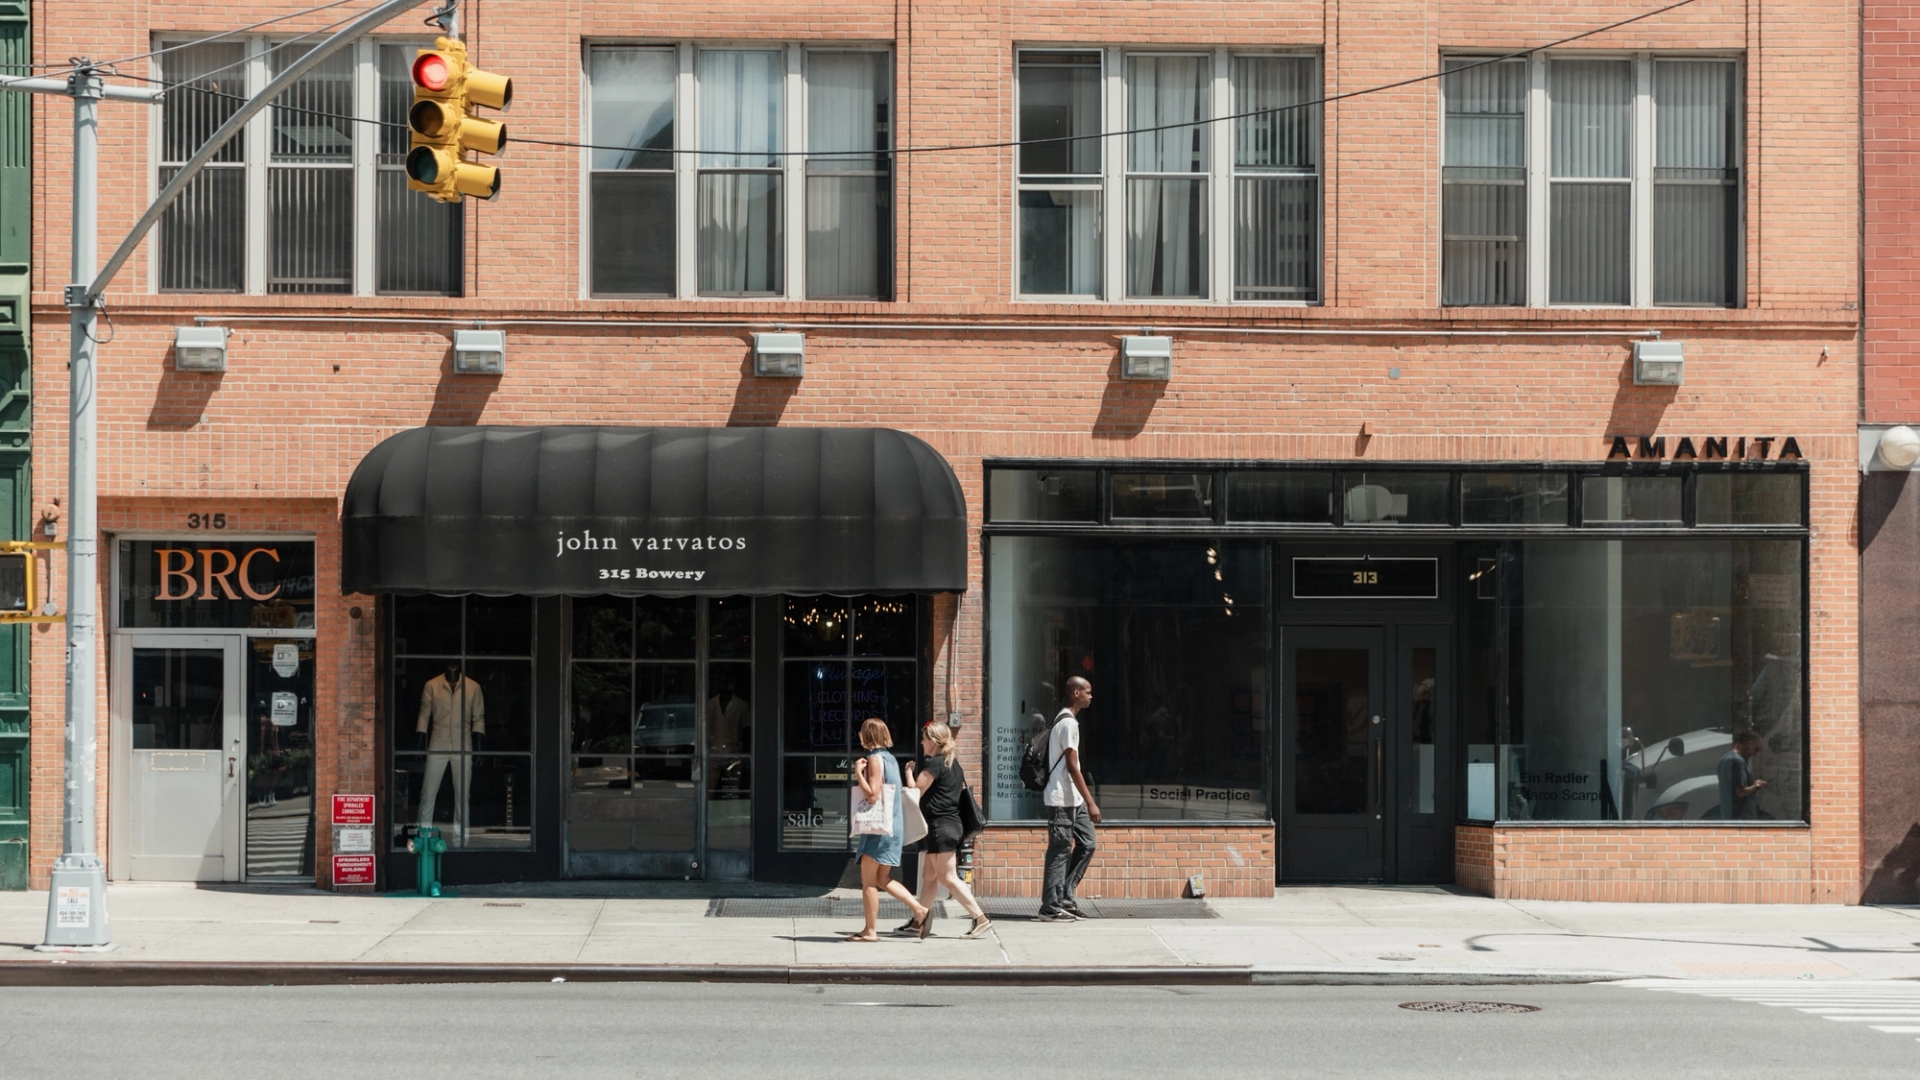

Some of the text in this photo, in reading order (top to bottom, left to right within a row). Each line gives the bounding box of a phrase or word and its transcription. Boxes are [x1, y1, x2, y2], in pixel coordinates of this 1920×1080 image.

[1607, 436, 1803, 459] AMANITA
[188, 513, 226, 529] 315
[556, 530, 746, 558] john varvatos
[154, 547, 281, 602] BRC
[599, 568, 706, 581] 315 Bowery
[1353, 571, 1378, 584] 313
[815, 663, 884, 686] Vinage
[817, 689, 879, 703] CLOTHING
[819, 709, 879, 722] RECORDS
[1520, 772, 1589, 784] Ein Radler
[1150, 788, 1250, 800] Social Practice
[1562, 789, 1602, 803] Scarpi
[787, 808, 823, 828] sale
